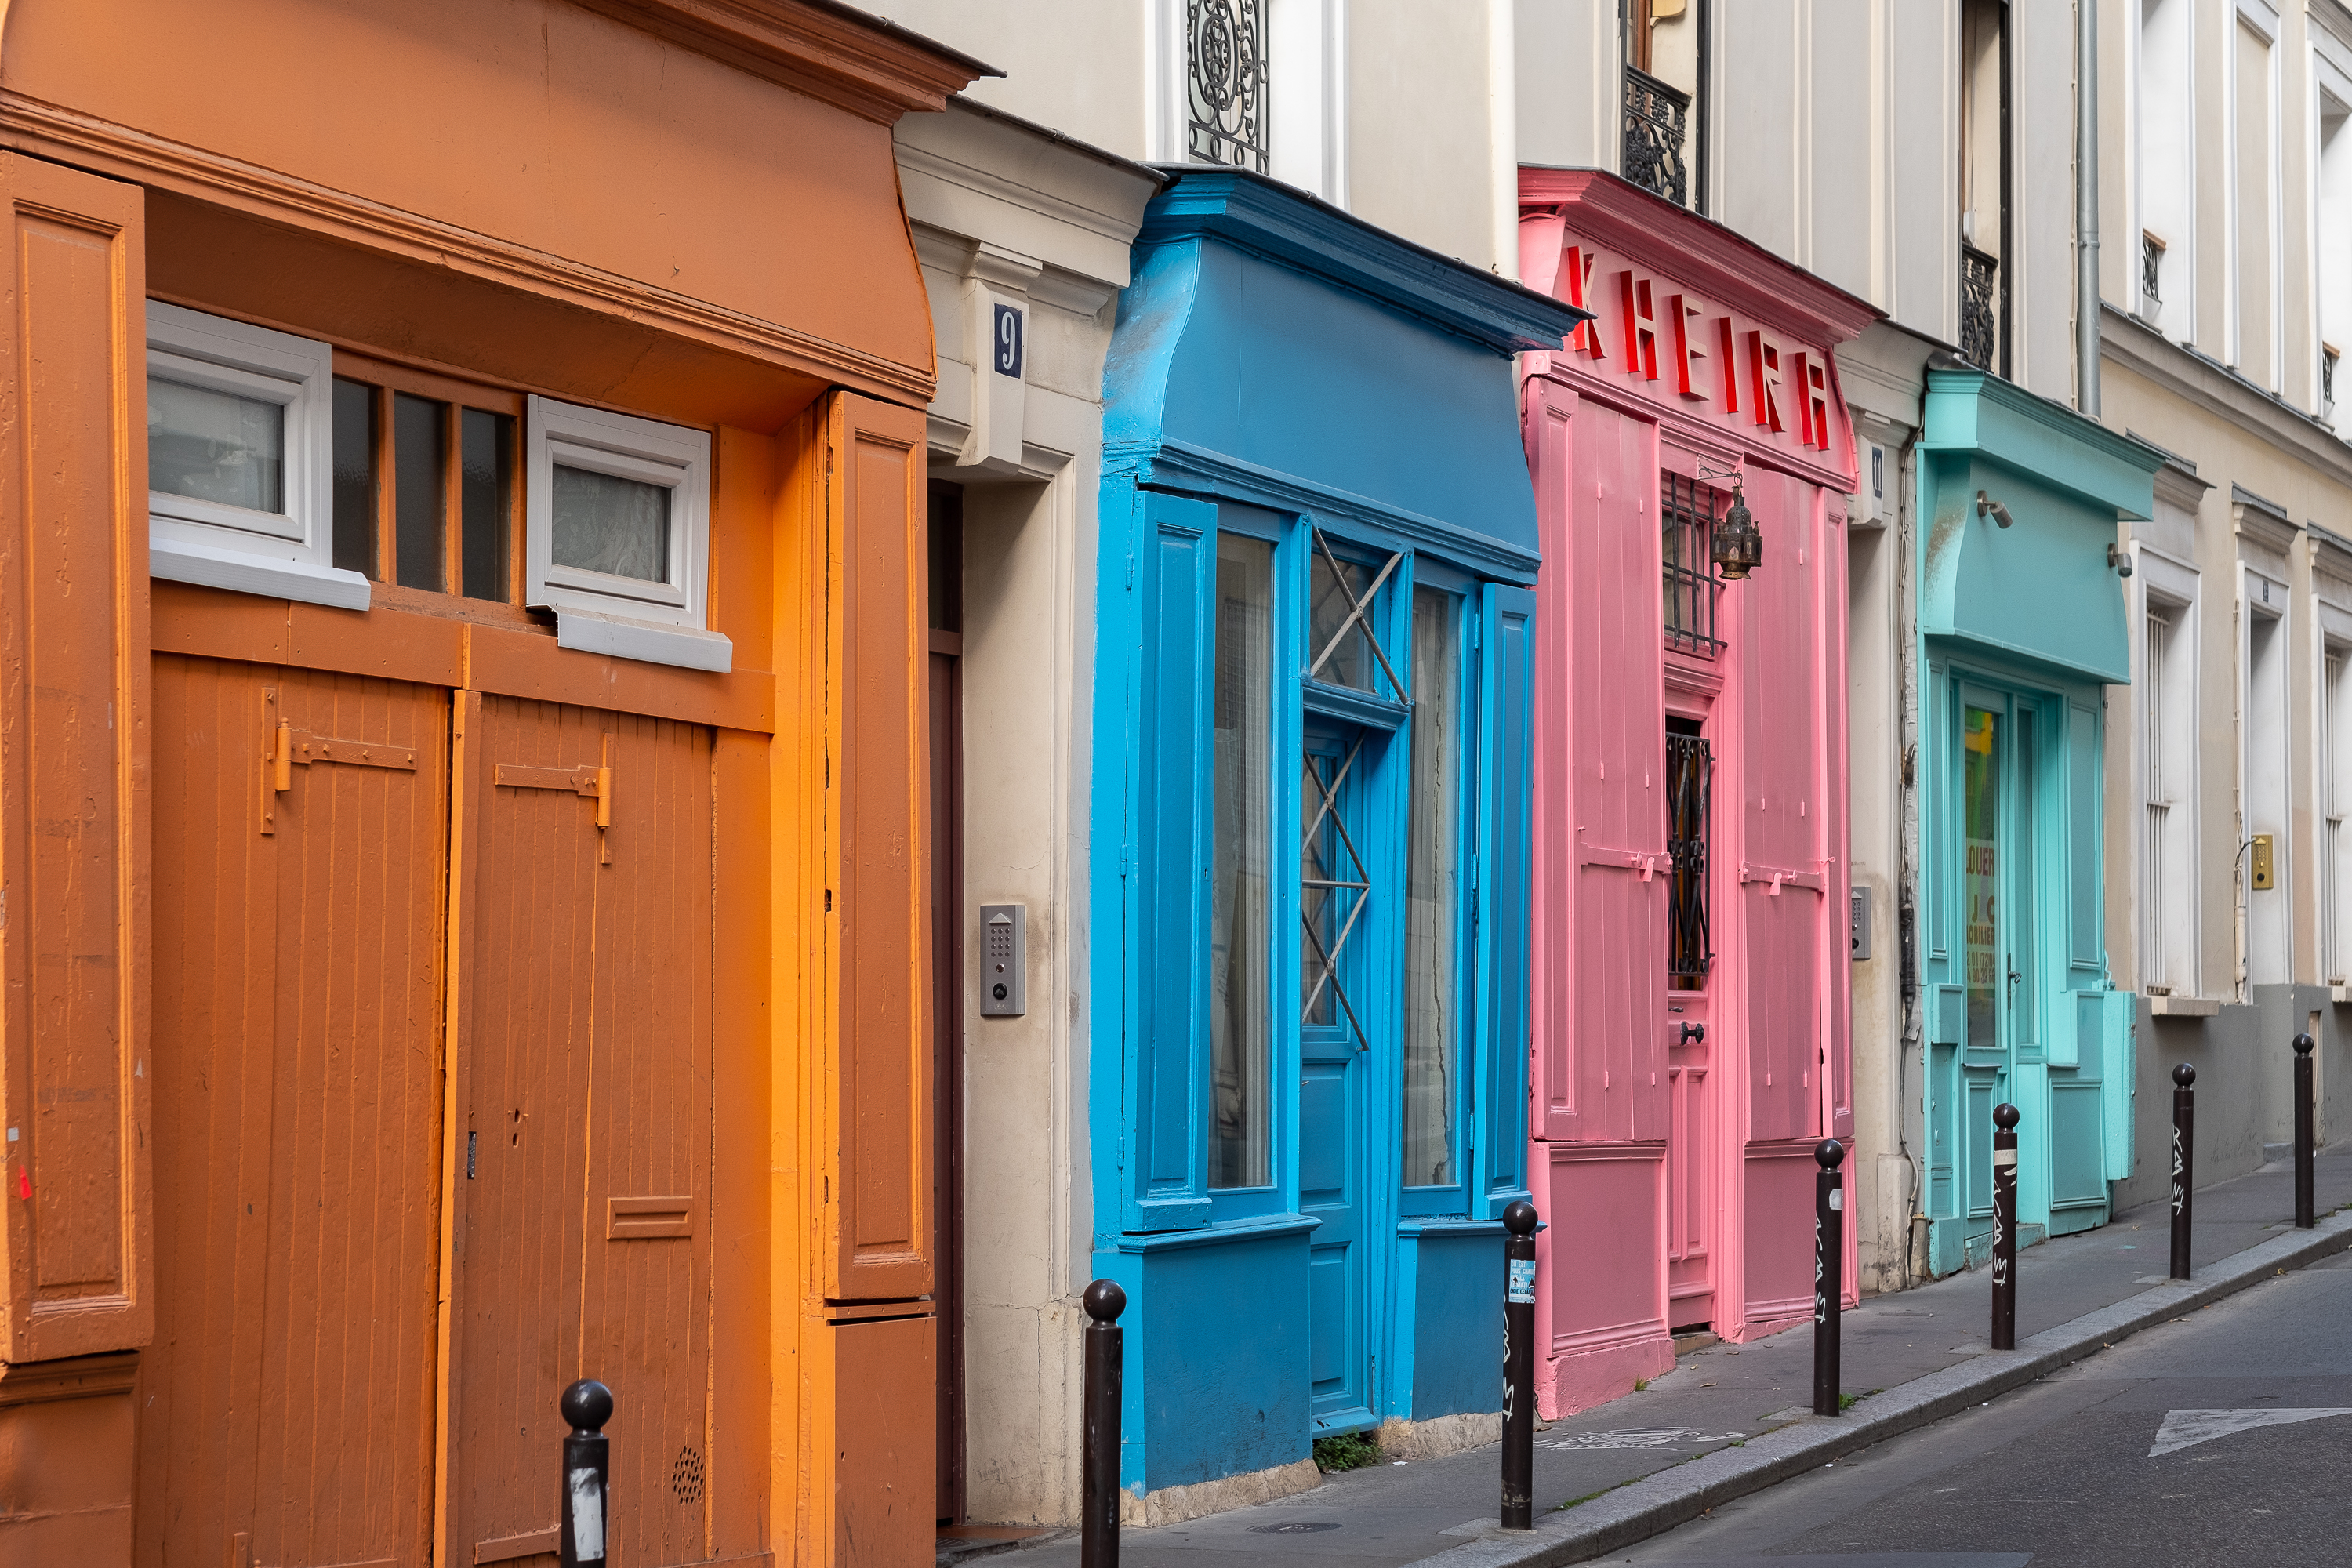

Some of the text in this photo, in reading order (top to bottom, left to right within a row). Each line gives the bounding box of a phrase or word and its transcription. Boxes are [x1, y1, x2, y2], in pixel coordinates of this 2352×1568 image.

[1000, 311, 1016, 370] 9
[1568, 246, 1831, 450] KHEIRA
[1873, 456, 1882, 492] 11
[1966, 845, 1994, 877] OUER
[1966, 925, 1994, 946] OBILIER
